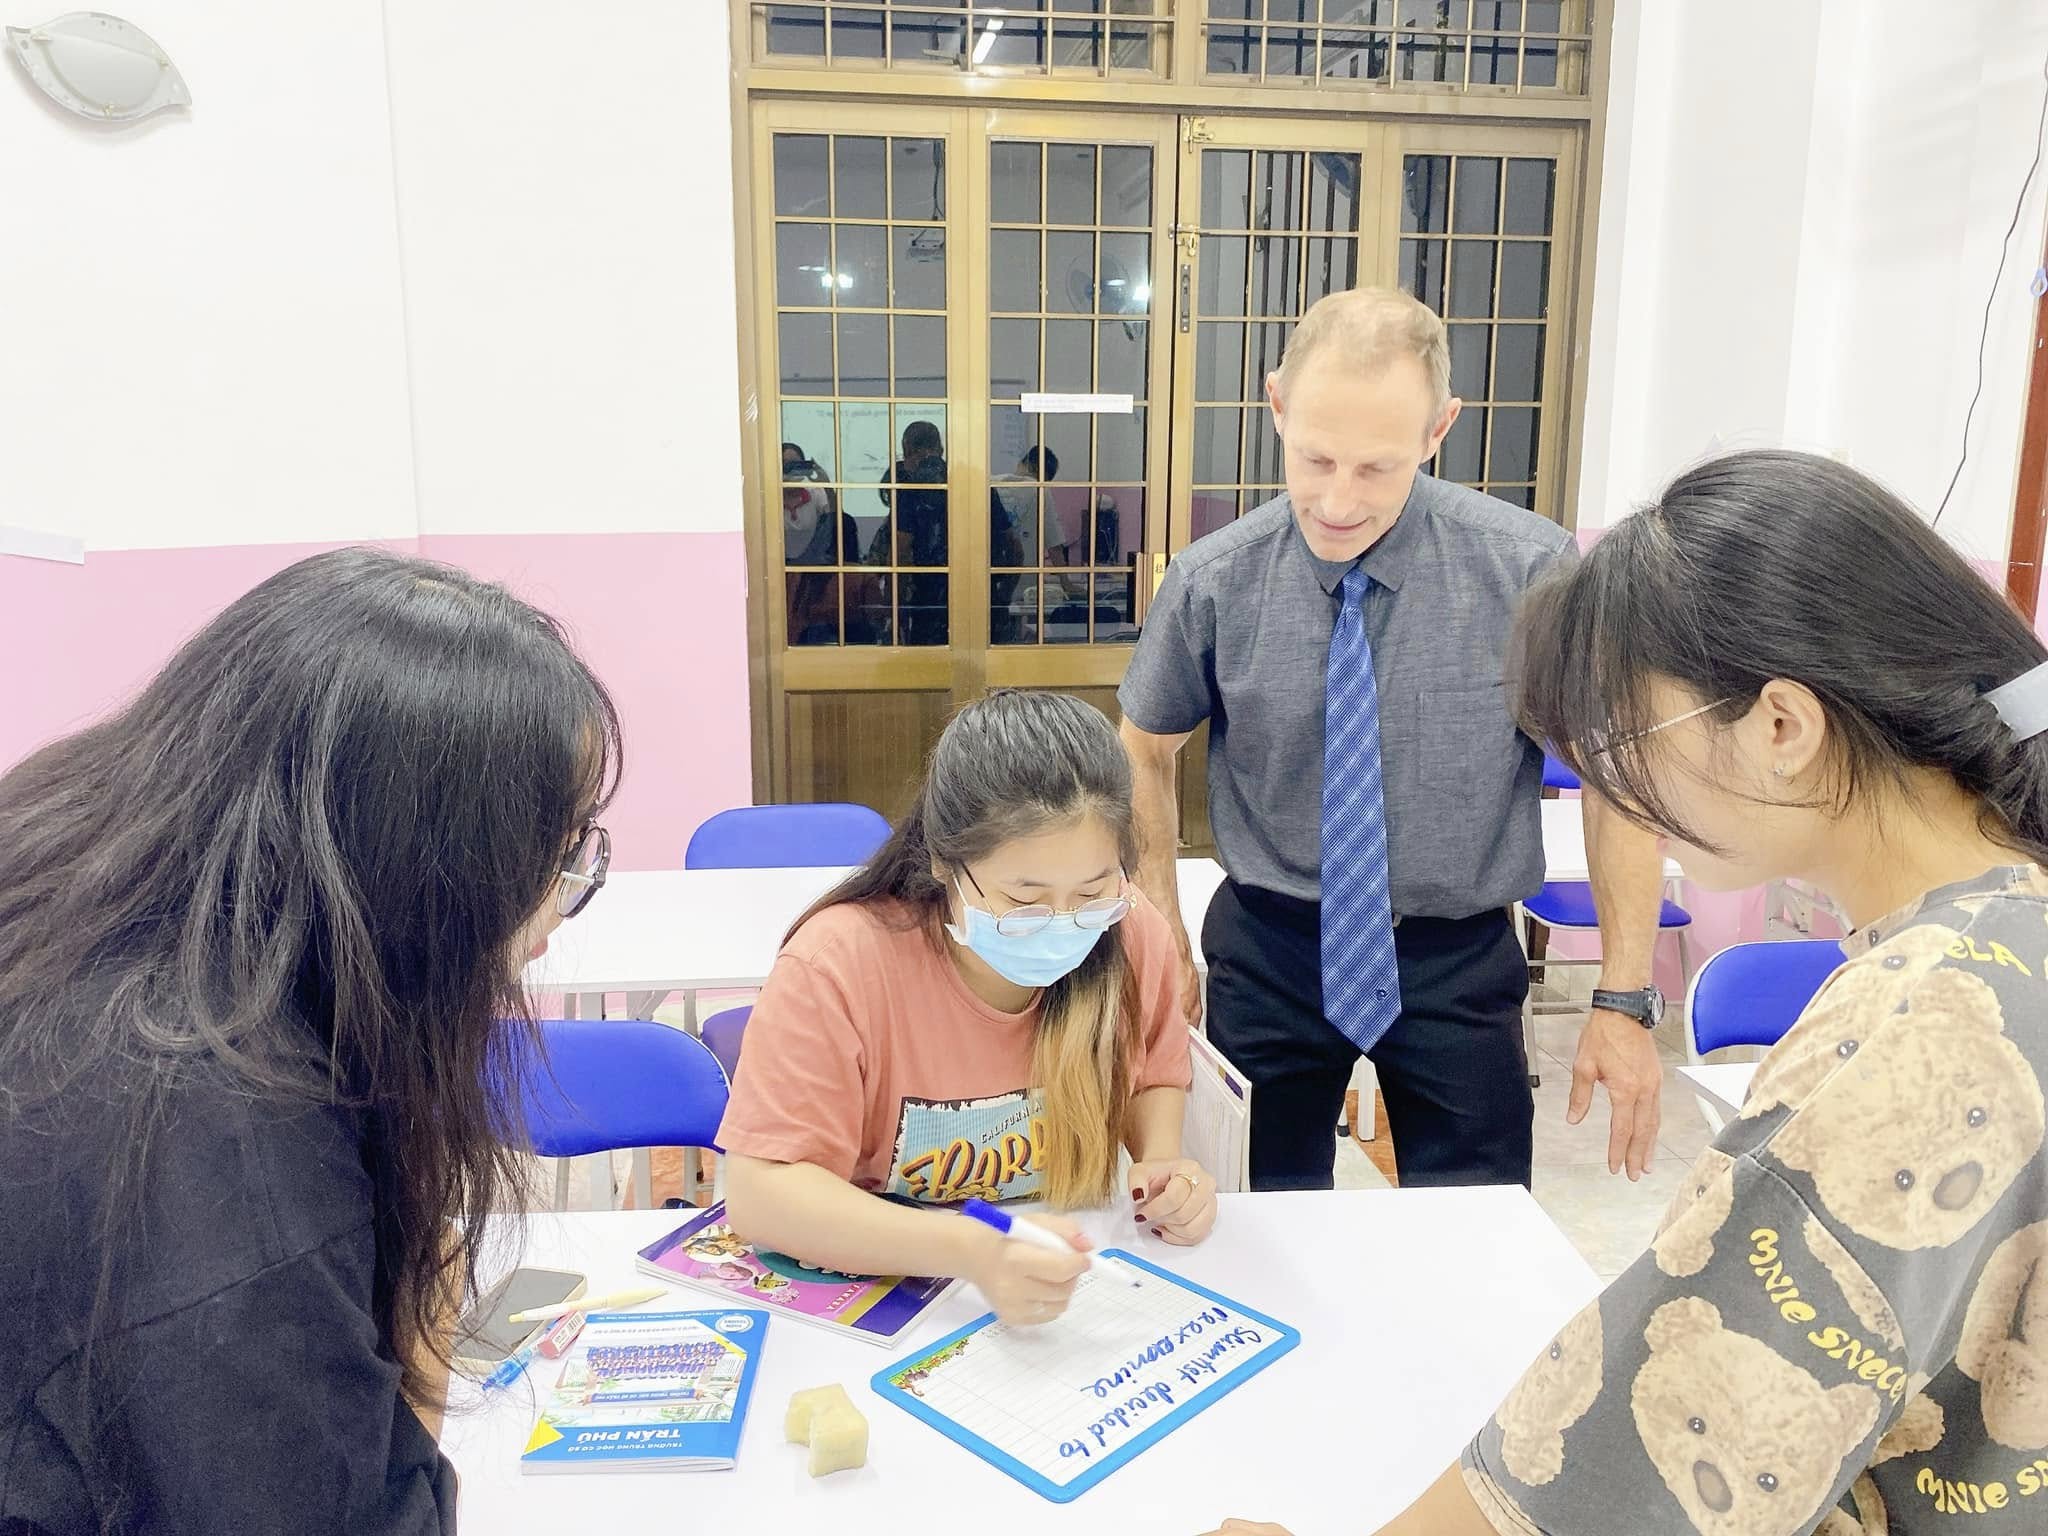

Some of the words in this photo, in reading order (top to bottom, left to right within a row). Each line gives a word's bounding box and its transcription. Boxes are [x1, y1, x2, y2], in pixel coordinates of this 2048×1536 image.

[1087, 1381, 1173, 1447] decided
[577, 1431, 621, 1445] PHÚ
[1059, 1437, 1091, 1458] to
